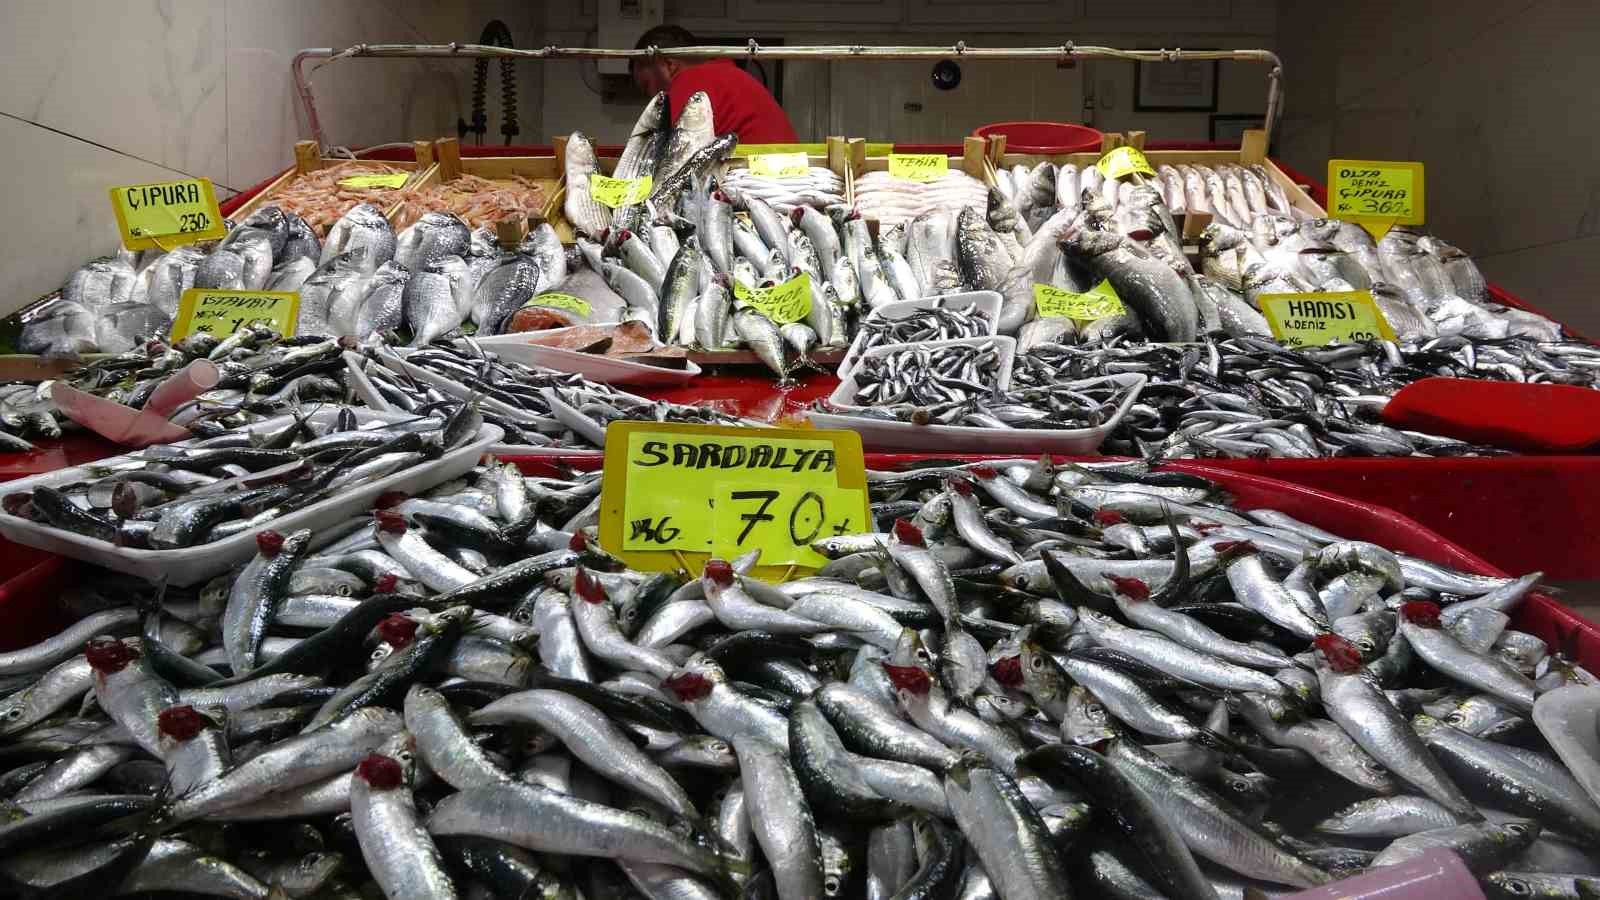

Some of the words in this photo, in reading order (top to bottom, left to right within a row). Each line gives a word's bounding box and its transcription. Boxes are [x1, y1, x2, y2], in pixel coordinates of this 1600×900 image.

[1288, 336, 1303, 346] KG
[633, 440, 837, 473] SARDALYA
[731, 489, 825, 548] 70
